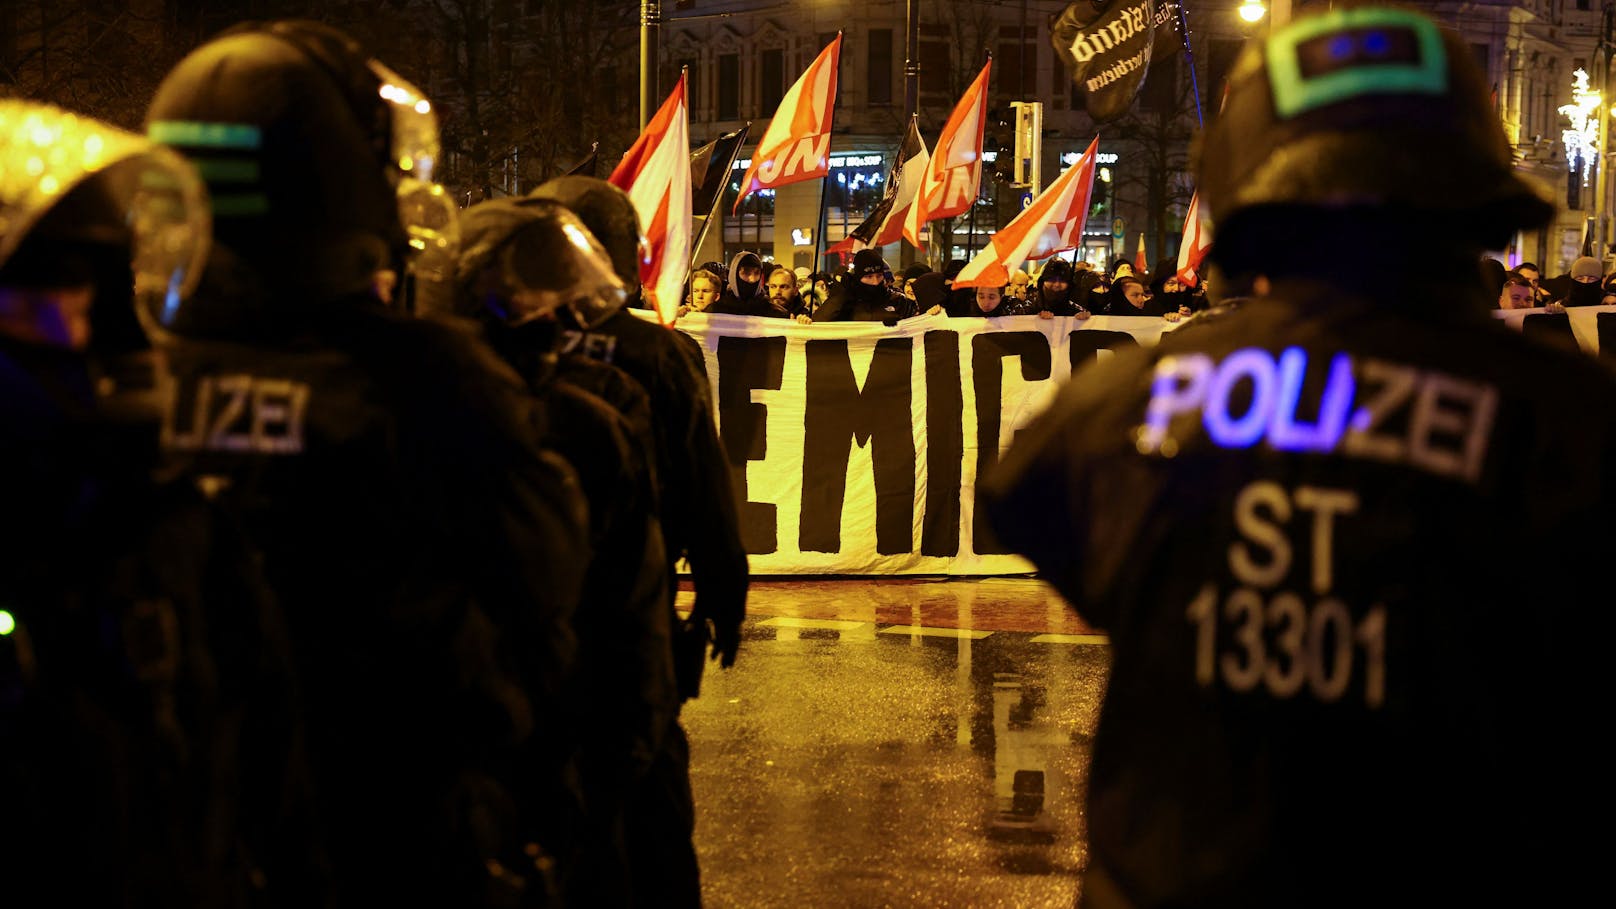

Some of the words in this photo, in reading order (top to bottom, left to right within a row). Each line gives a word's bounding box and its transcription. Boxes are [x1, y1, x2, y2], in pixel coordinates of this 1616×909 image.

[757, 132, 831, 184] JN
[1137, 345, 1498, 484] POLIZEI
[1227, 479, 1360, 595] ST
[1184, 583, 1389, 710] 13301
